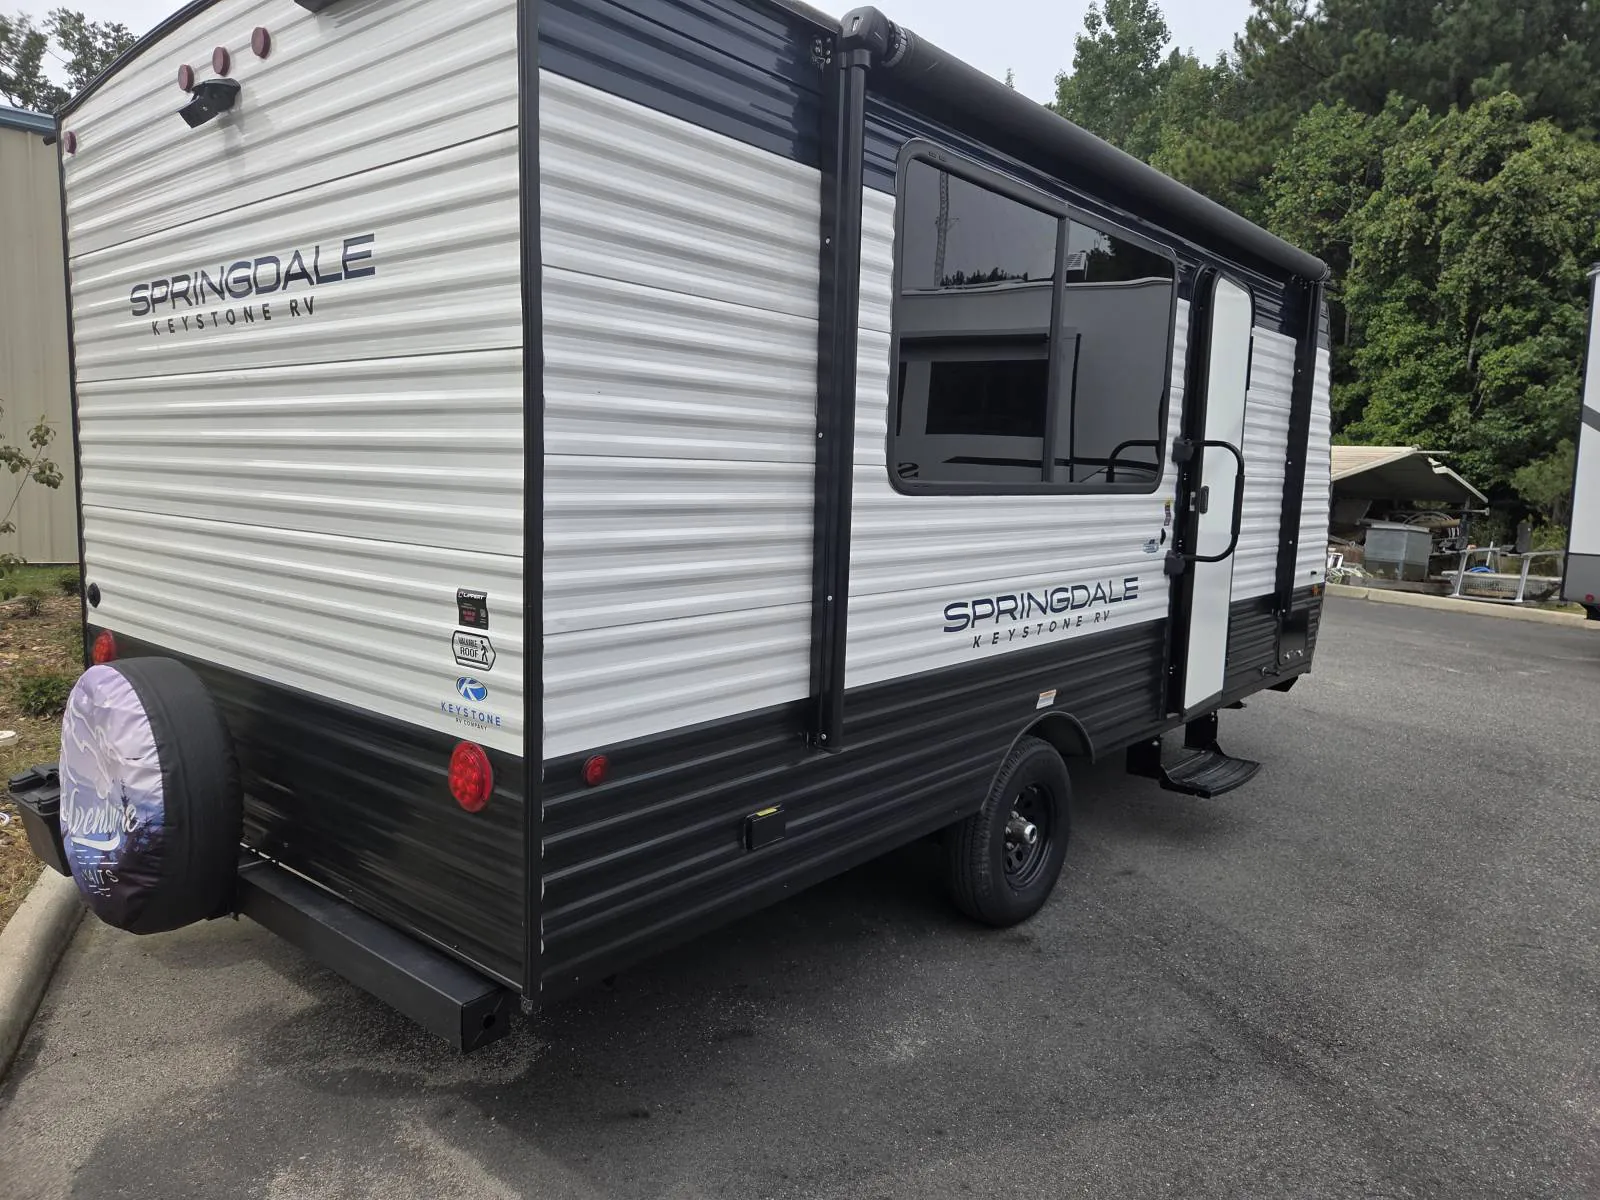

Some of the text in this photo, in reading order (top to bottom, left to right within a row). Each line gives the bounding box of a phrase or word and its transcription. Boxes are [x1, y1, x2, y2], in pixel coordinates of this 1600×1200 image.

[130, 233, 375, 316] SPRINGDALE
[152, 296, 315, 335] KEYSTONE RV
[943, 577, 1139, 632] SPRINGDALE
[973, 610, 1110, 648] KEYSTONE RV
[460, 646, 479, 658] ROOF
[440, 702, 501, 727] KEYSTONE
[463, 719, 487, 731] COMPANY
